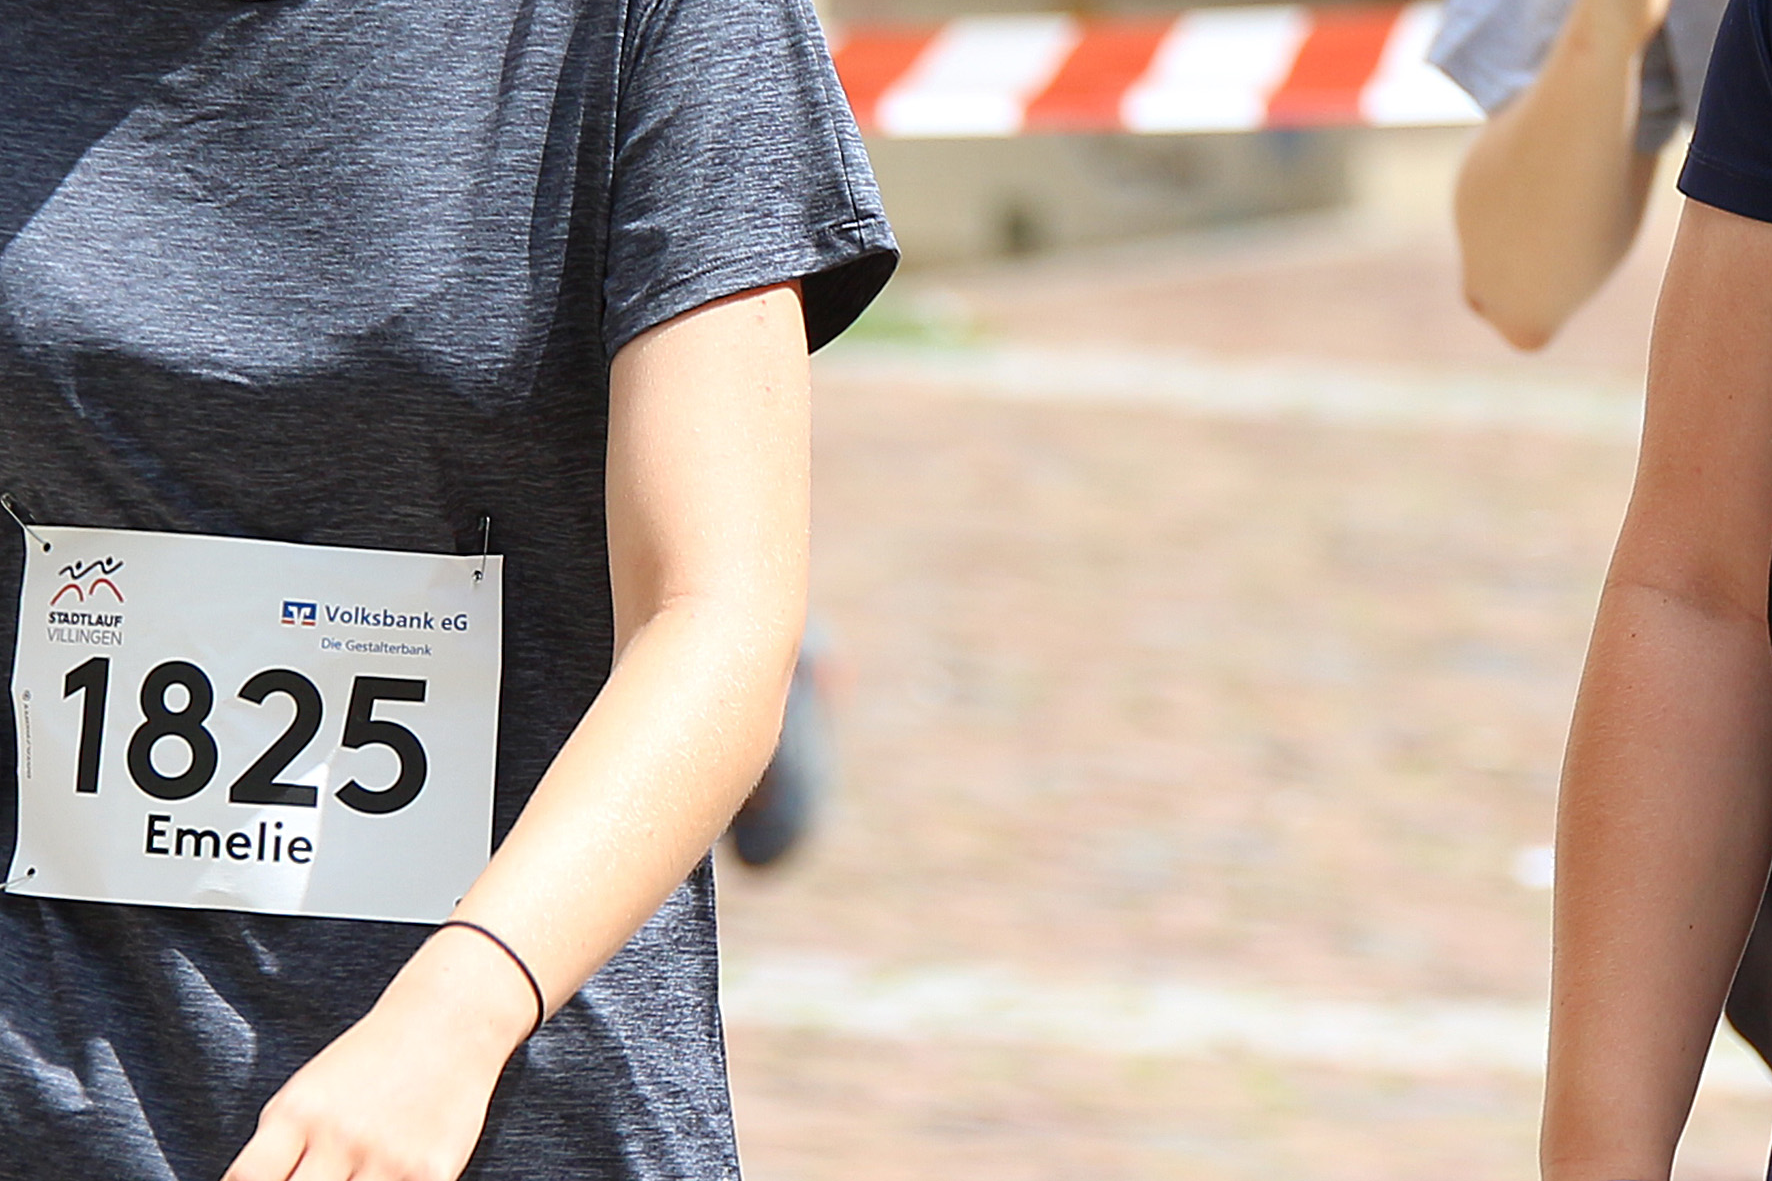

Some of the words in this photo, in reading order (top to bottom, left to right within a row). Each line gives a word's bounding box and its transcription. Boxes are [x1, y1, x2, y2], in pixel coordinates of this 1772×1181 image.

[48, 611, 123, 627] STADTLAUF
[325, 605, 435, 630] Volksbank
[441, 613, 468, 631] eG
[47, 627, 123, 645] VILLINGEN
[321, 637, 342, 650] Die
[345, 639, 432, 656] Gestalterbank
[64, 657, 428, 815] 1825
[146, 815, 314, 864] Emelie
